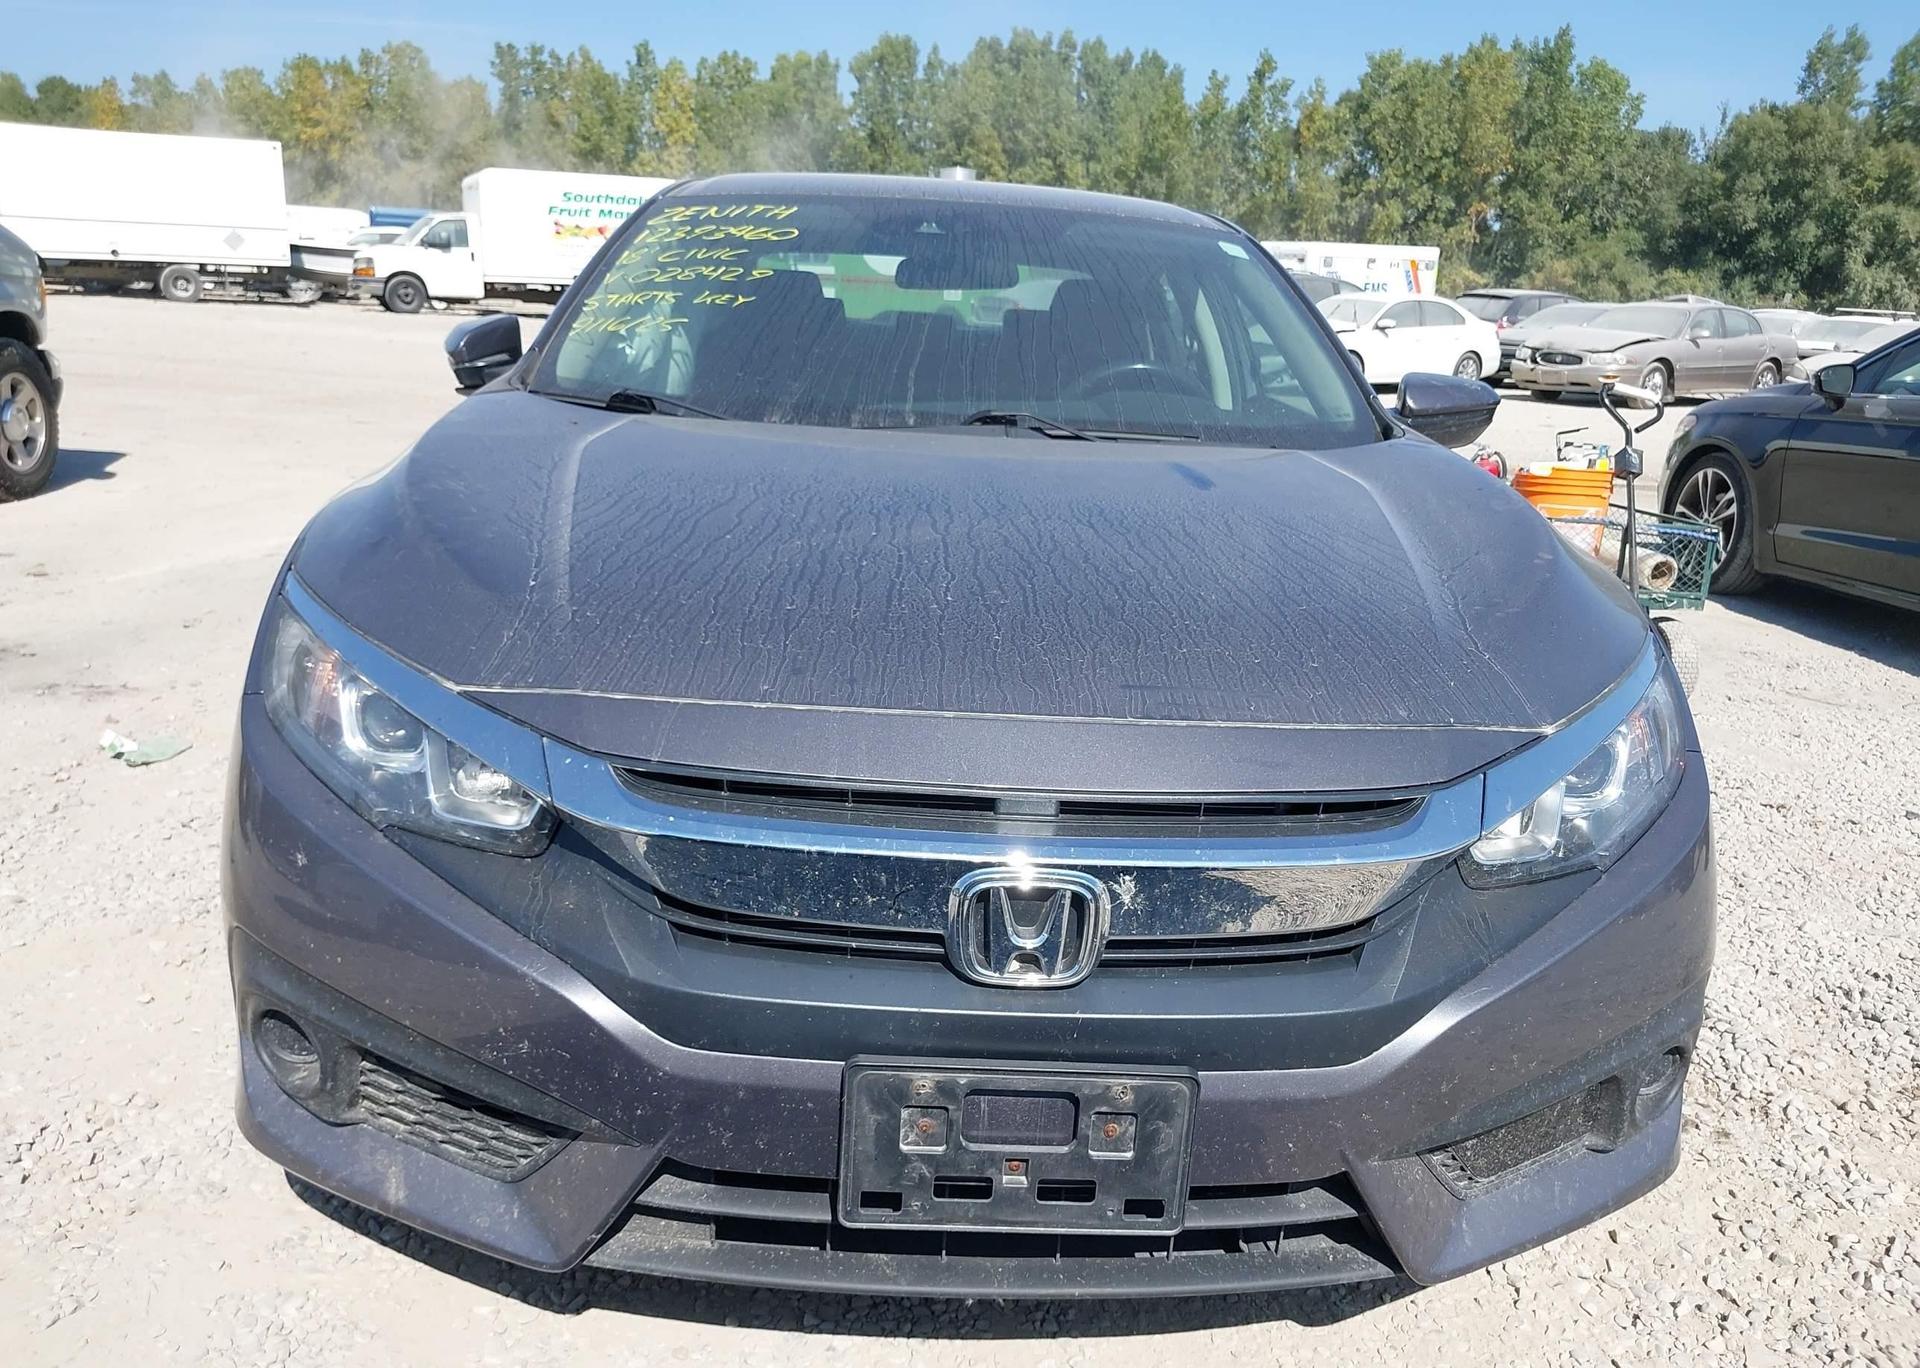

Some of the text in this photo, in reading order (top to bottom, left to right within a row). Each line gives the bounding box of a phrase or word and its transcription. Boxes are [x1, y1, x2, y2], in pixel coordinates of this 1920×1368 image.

[563, 191, 646, 207] Southdal
[548, 206, 634, 219] Fruit Mar
[647, 205, 798, 225] ZENITH
[657, 248, 749, 262] CIVIC
[582, 291, 756, 311] STARTS KEY
